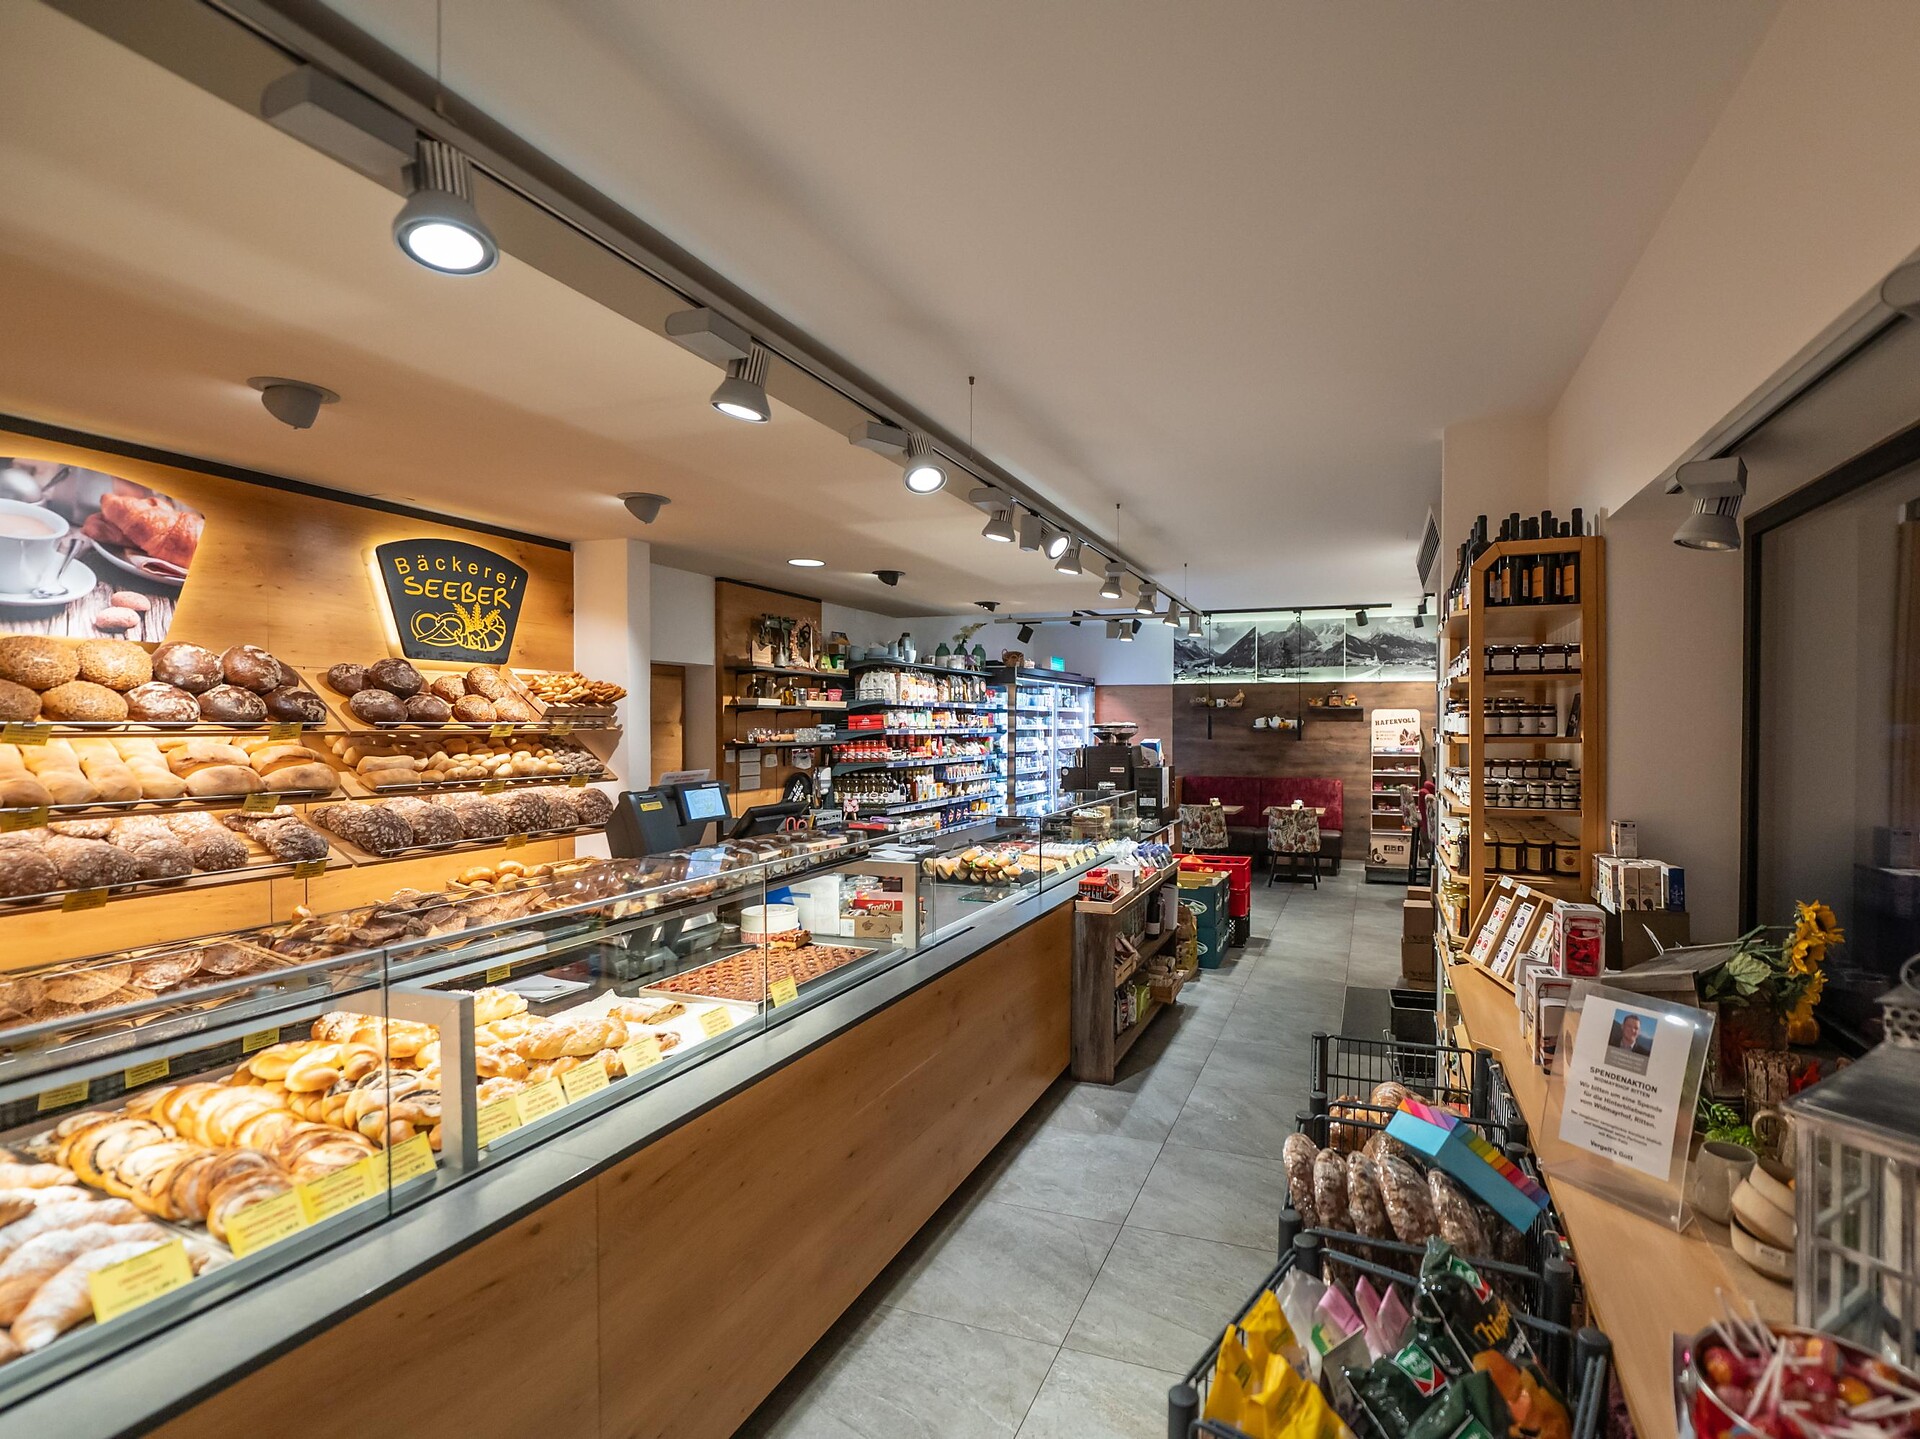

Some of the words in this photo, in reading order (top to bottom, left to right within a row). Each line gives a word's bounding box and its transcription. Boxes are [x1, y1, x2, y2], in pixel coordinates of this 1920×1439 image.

[393, 554, 518, 590] Bäckerei
[403, 575, 512, 610] SEEBER
[1589, 1066, 1658, 1094] SPENDENAKTION
[1591, 1084, 1609, 1095] bitten
[1622, 1095, 1635, 1104] eine
[1637, 1099, 1663, 1113] Spende
[1590, 1139, 1618, 1156] Vergelt's
[1618, 1150, 1634, 1161] Gott
